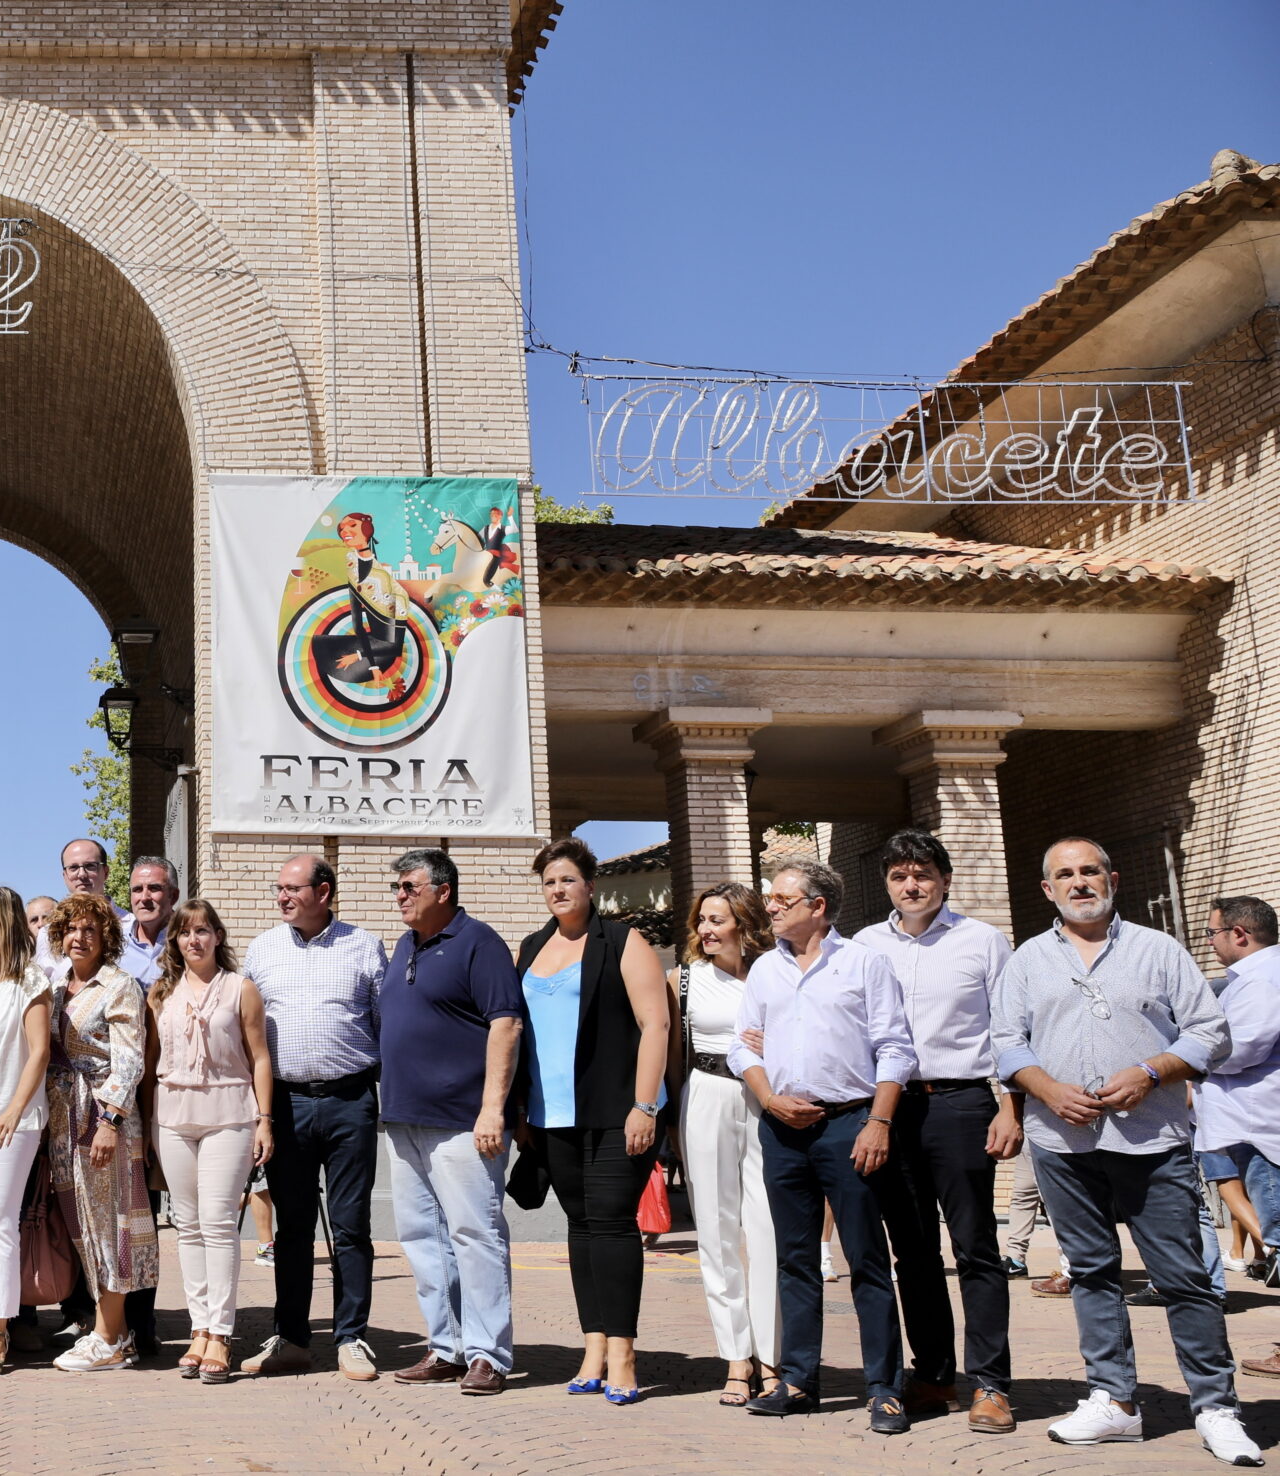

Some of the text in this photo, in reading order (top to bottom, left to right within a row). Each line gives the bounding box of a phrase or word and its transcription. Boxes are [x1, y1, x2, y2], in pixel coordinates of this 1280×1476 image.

[595, 382, 1170, 498] Albacete
[259, 754, 485, 794] FERIA
[275, 795, 485, 817] ALBACETE
[290, 816, 299, 824] 7
[447, 819, 482, 827] 2022
[680, 968, 689, 996] TOUS
